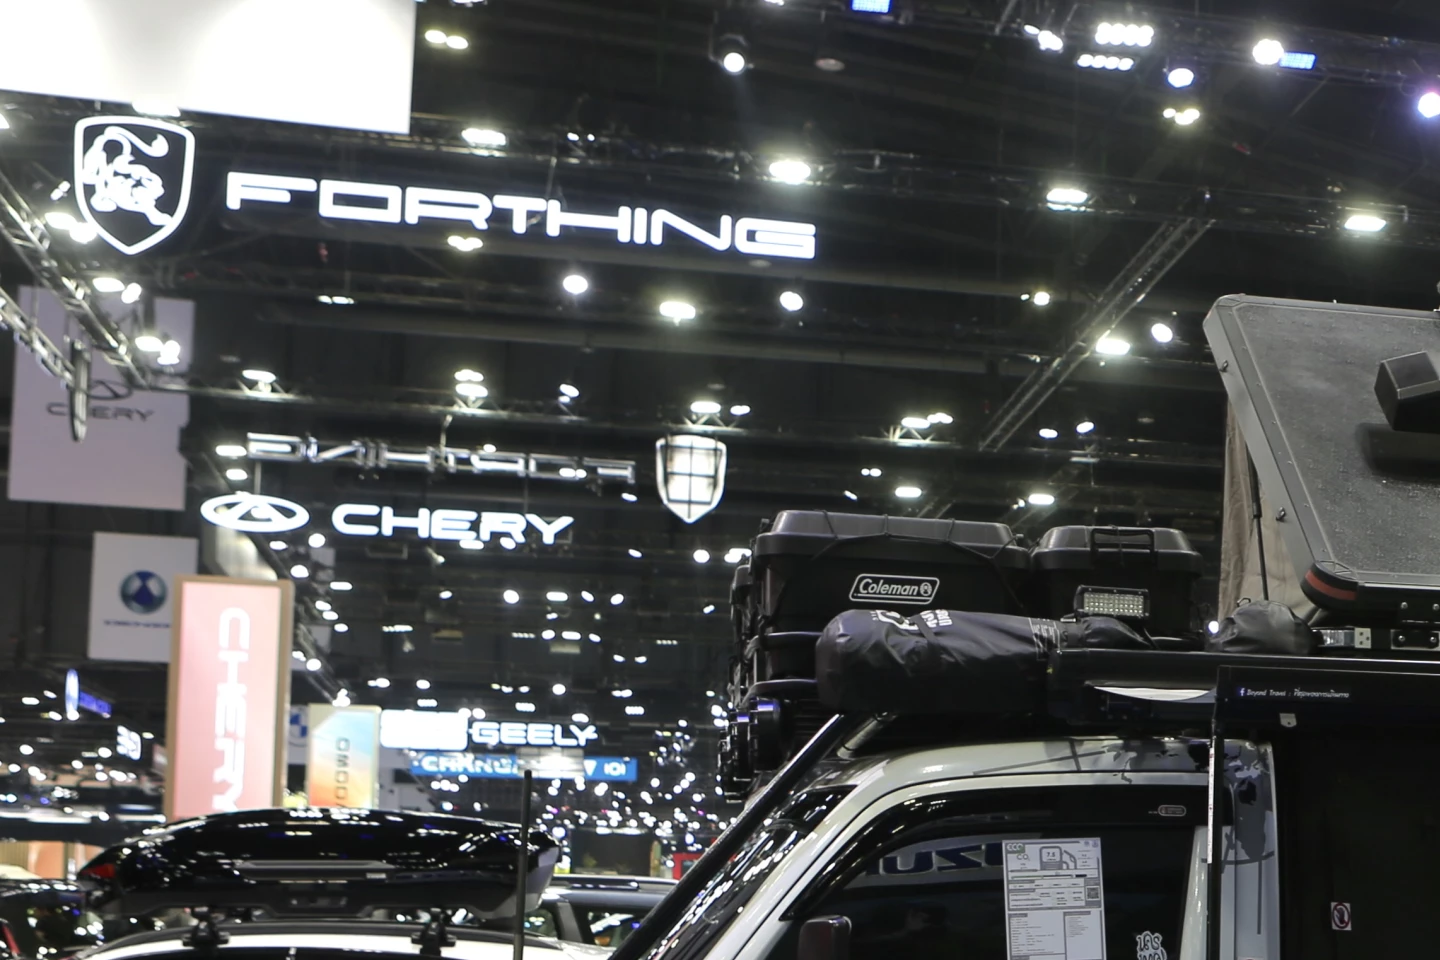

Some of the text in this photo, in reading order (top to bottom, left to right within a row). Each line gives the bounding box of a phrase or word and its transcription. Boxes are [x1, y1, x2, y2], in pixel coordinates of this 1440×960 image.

[226, 171, 817, 260] FORTHING
[46, 402, 153, 421] CERY
[331, 503, 574, 545] CHERY
[859, 578, 918, 596] Coleman
[472, 721, 594, 747] GEELY
[335, 737, 350, 808] OMOD
